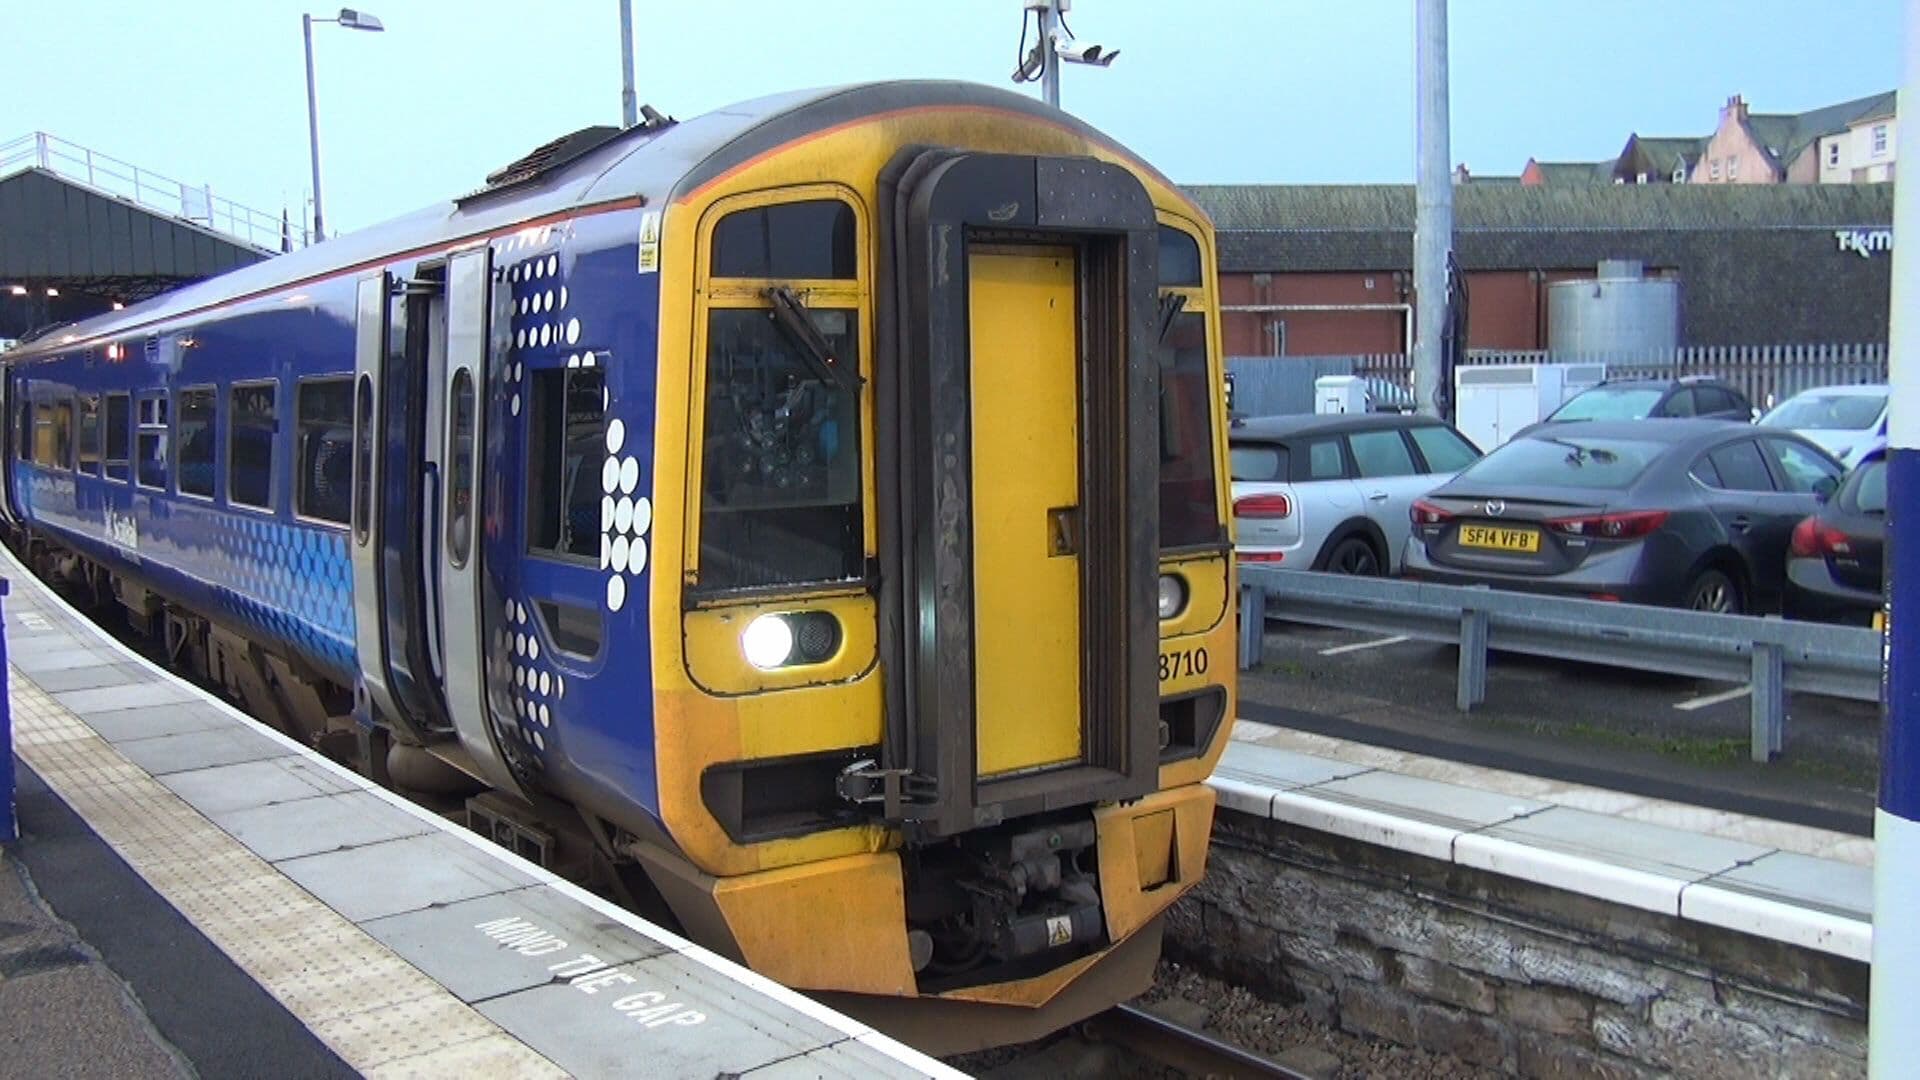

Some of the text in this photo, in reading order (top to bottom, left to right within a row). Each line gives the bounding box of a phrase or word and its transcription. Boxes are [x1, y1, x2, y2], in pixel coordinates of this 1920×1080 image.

[1467, 528, 1528, 548] SF14 VFB
[1159, 647, 1207, 681] 8710
[474, 916, 707, 1029] MIND THE GAP
